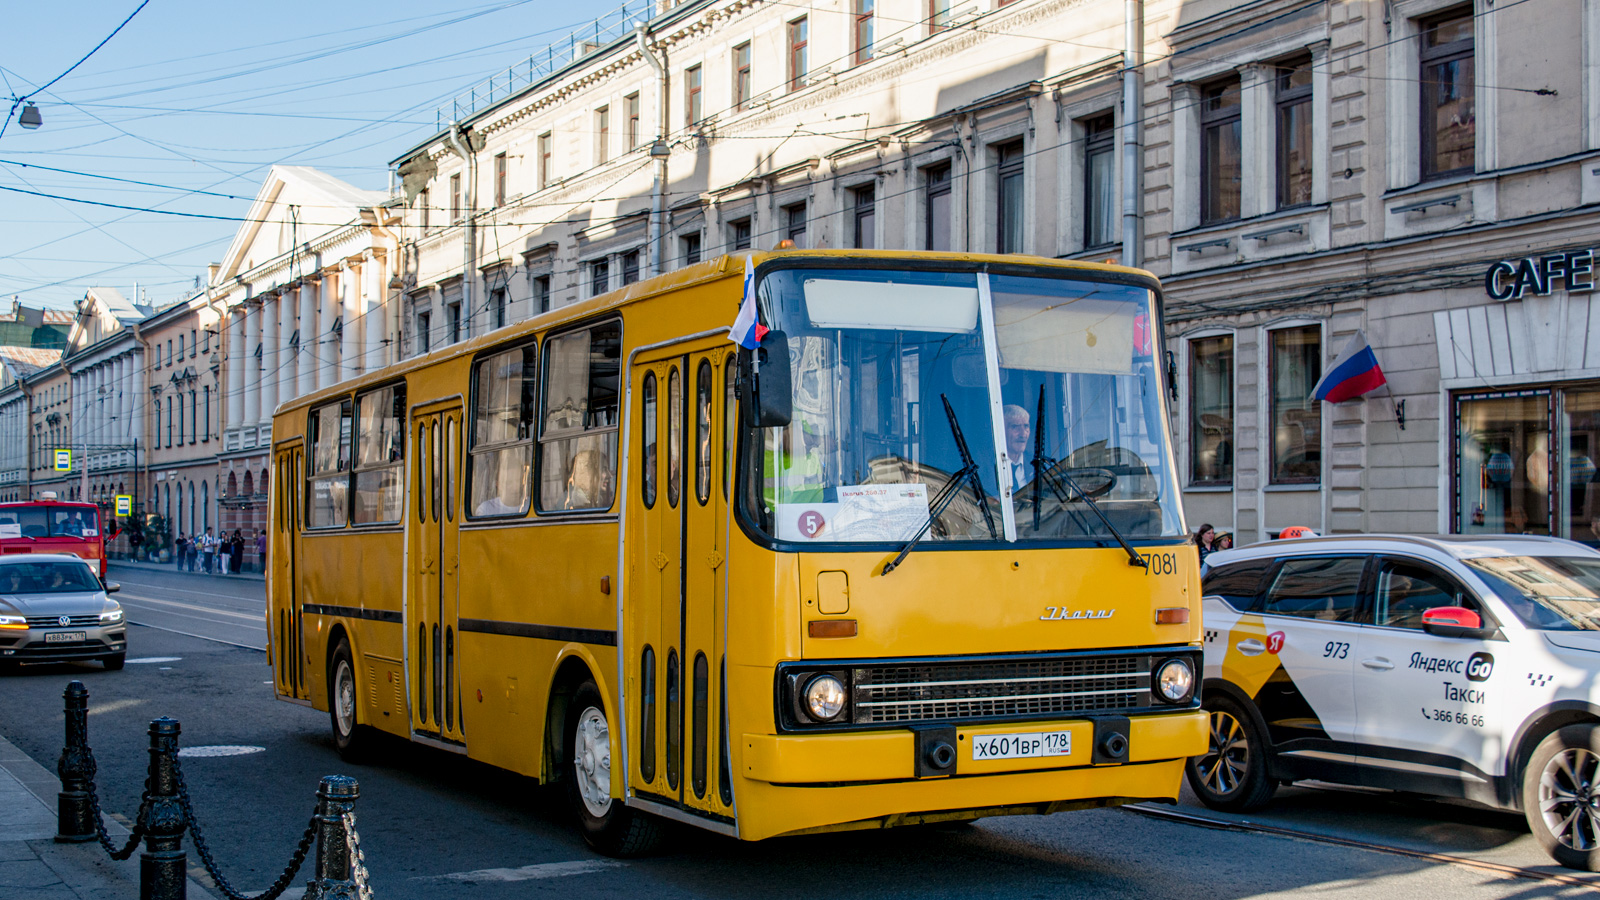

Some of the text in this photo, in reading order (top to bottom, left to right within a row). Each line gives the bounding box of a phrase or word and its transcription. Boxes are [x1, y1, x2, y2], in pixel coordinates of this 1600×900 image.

[1485, 249, 1595, 301] CAFE
[806, 515, 817, 534] 5
[1141, 553, 1177, 575] 7081
[1040, 606, 1116, 621] Ikarus
[1269, 634, 1282, 651] Я
[1323, 641, 1350, 660] 973
[1408, 651, 1493, 678] Яндекс Go
[1443, 681, 1485, 704] Такси
[1433, 709, 1485, 727] 366 66 66
[1045, 733, 1067, 748] 178
